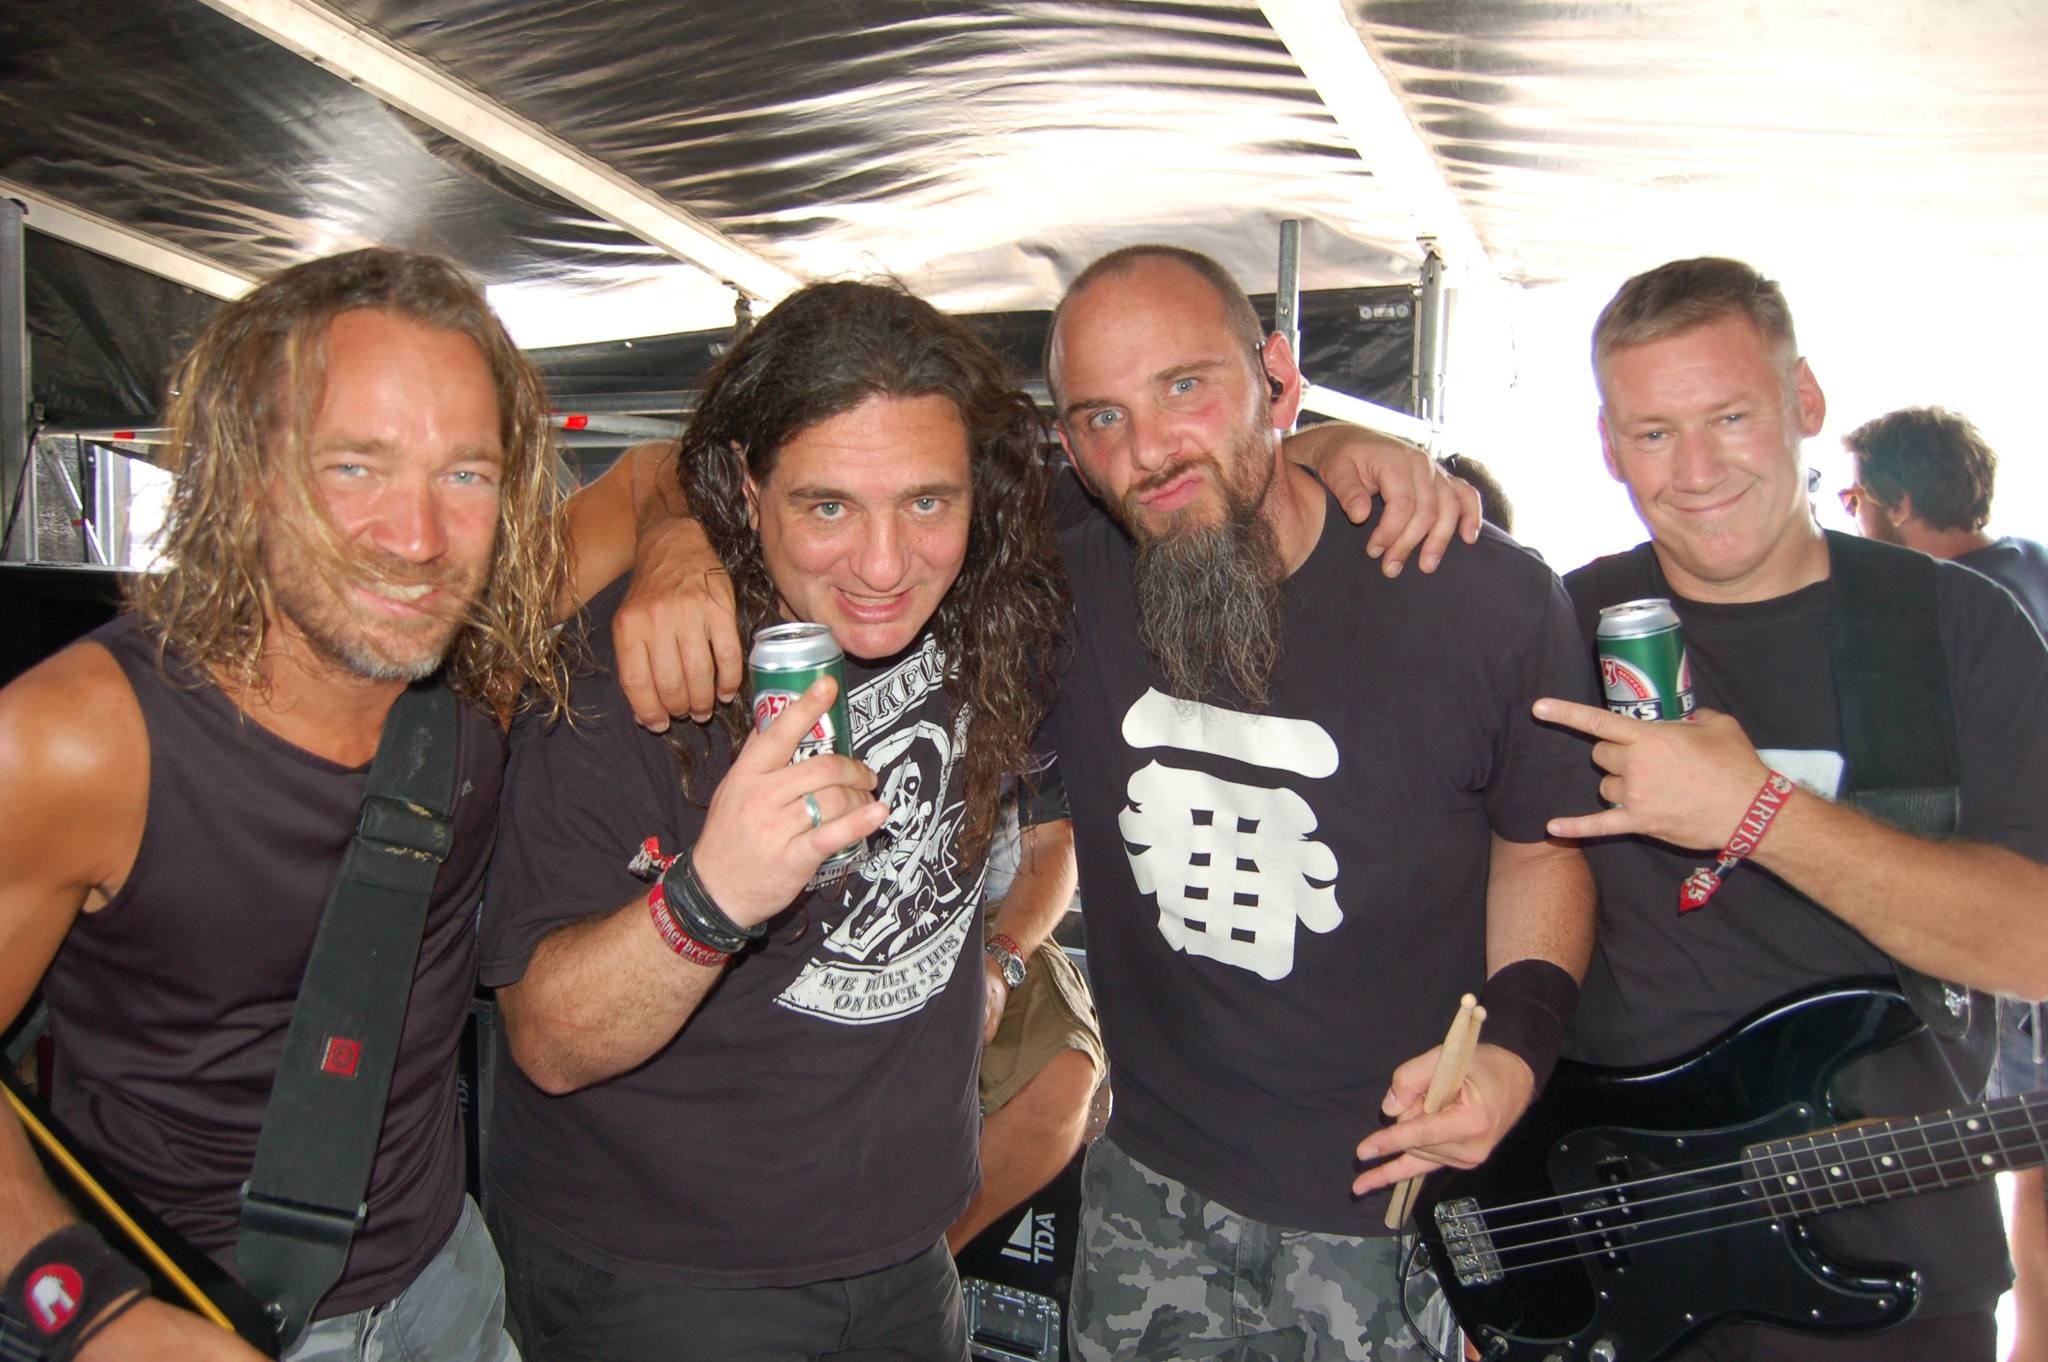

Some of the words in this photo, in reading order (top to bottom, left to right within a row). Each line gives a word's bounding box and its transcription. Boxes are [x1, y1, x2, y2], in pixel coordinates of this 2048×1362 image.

[820, 972, 858, 992] WE
[866, 983, 920, 1011] ROCK
[1034, 1213, 1056, 1264] TDA
